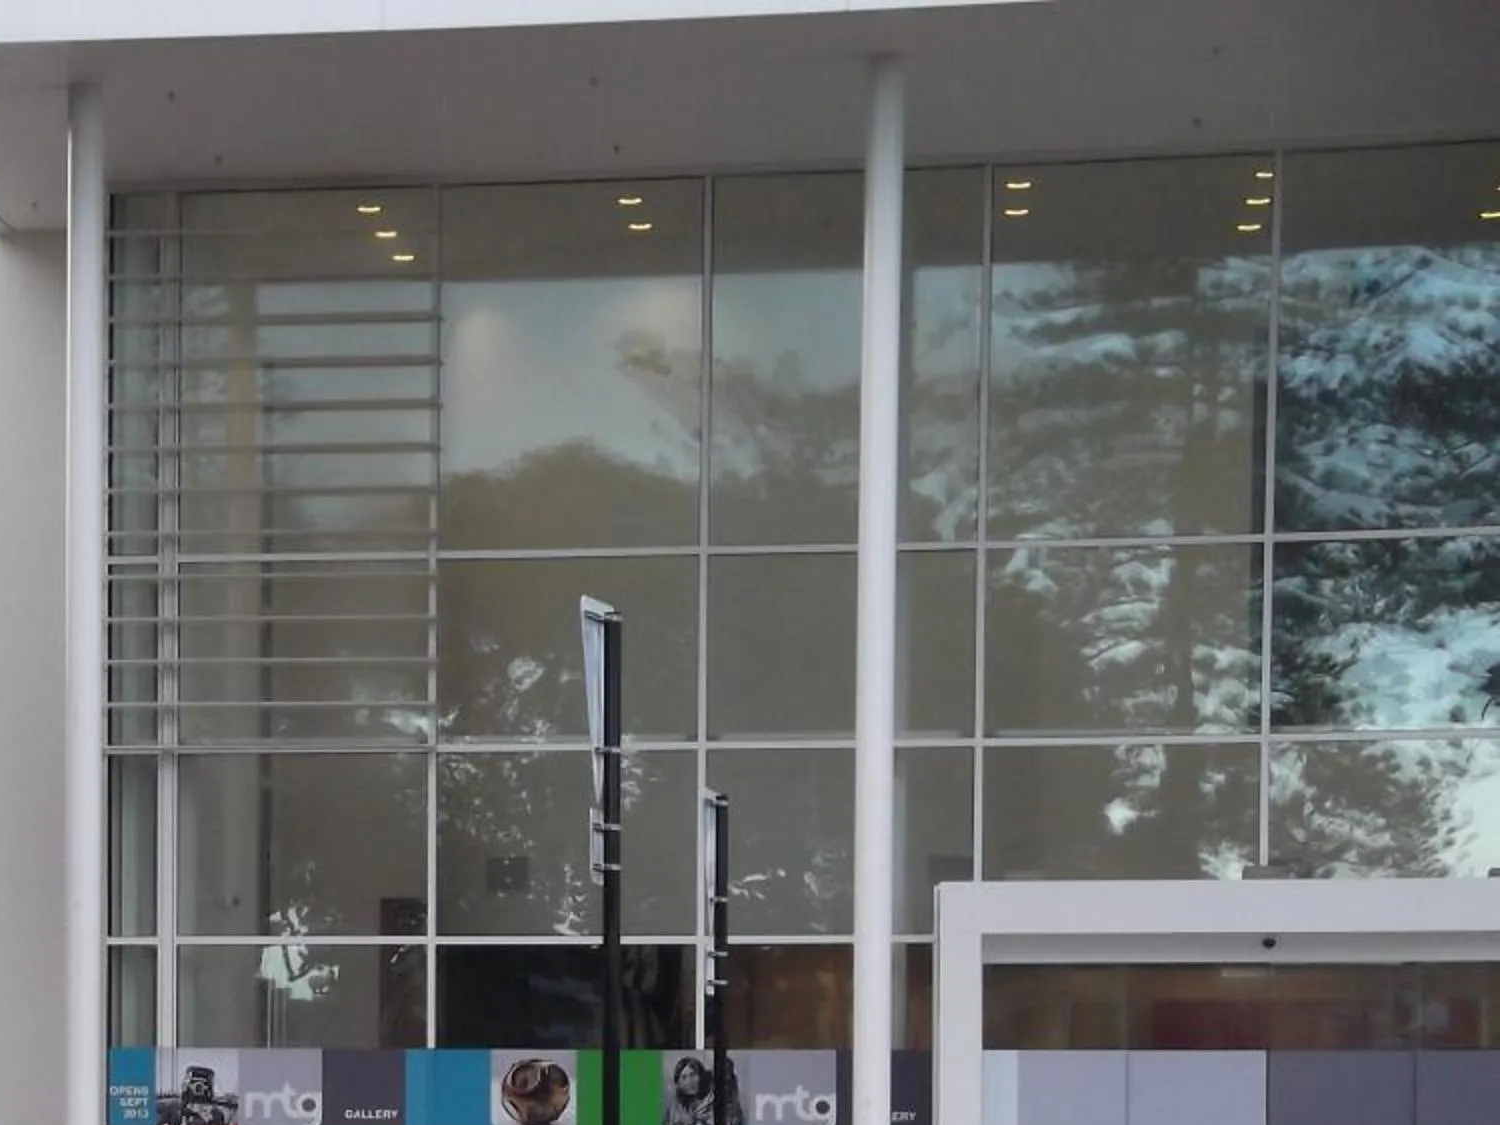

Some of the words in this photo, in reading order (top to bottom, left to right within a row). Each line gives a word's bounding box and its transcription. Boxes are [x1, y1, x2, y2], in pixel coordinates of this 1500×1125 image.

[109, 1086, 148, 1096] OPENS
[120, 1098, 148, 1107] SEPT
[345, 1109, 398, 1119] GALLERY
